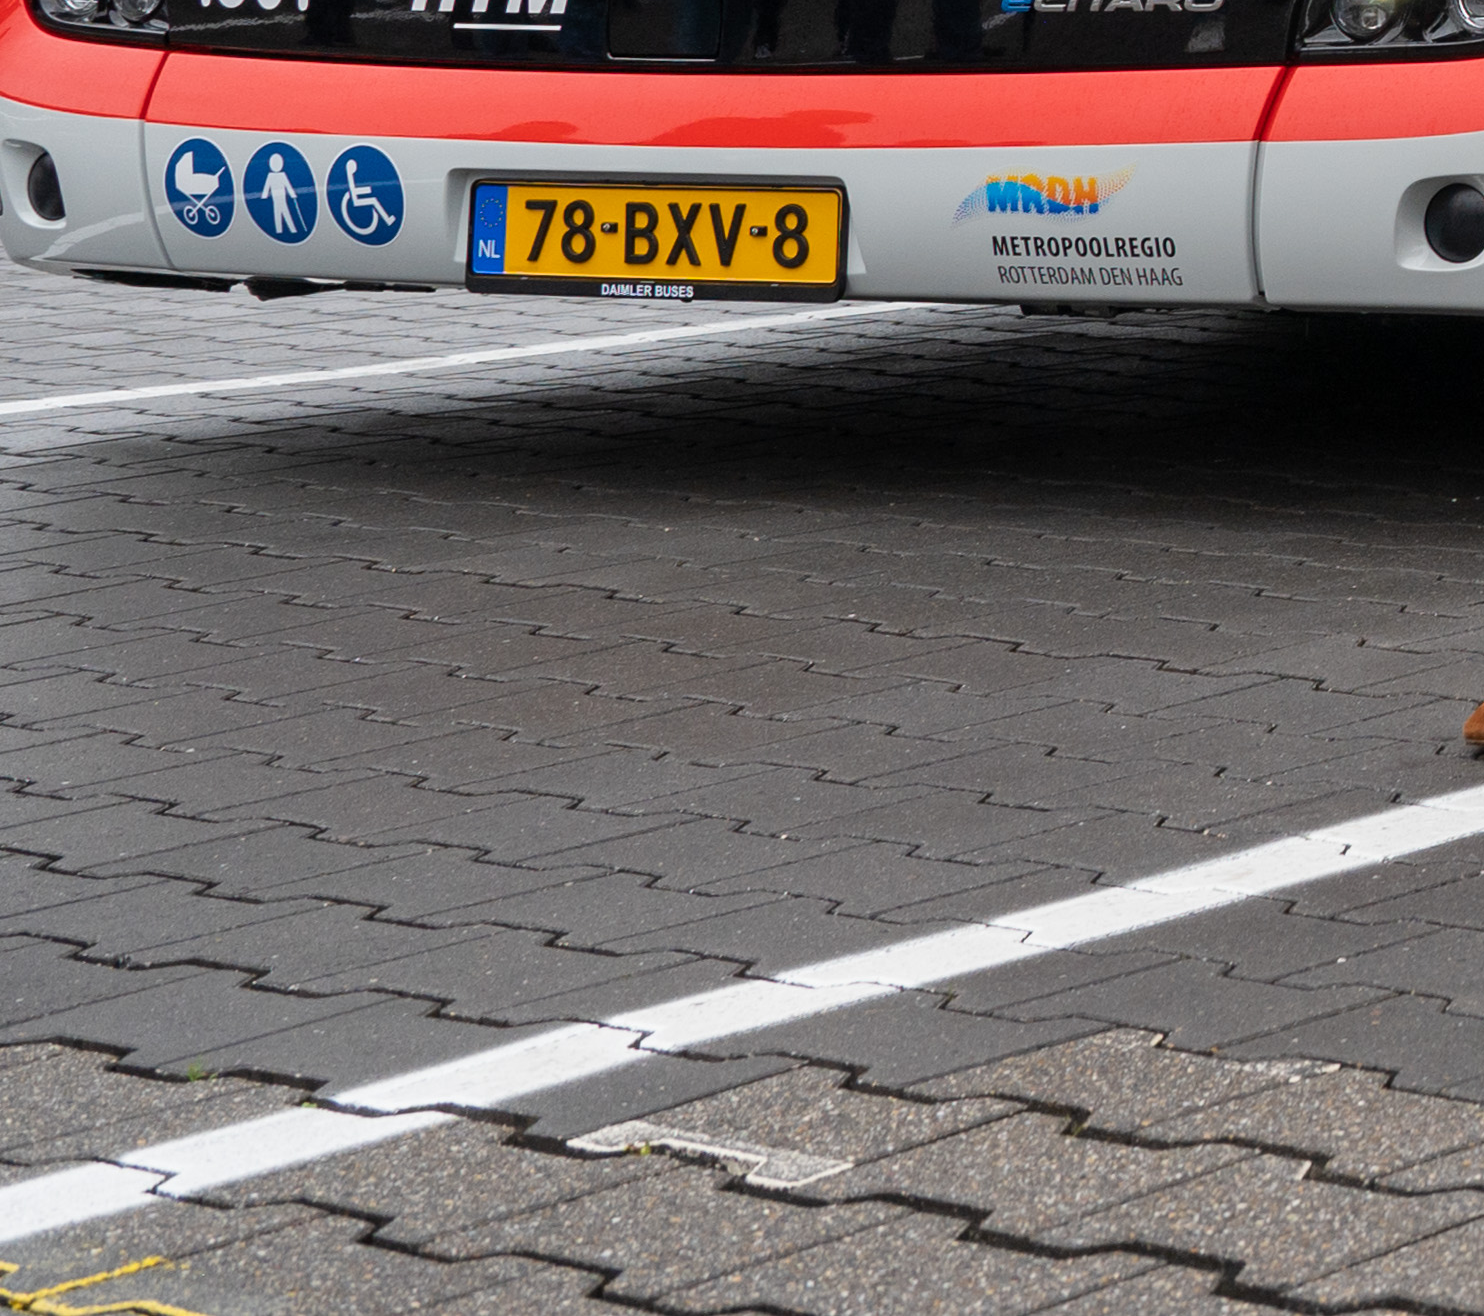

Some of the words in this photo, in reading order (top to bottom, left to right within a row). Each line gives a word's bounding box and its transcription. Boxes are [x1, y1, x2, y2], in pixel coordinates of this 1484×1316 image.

[986, 173, 1100, 215] MRDH
[524, 199, 810, 269] 78-BXV-8
[477, 239, 500, 259] NL
[991, 235, 1177, 258] METROPOOLREGIO
[997, 265, 1097, 285] ROTTERDAM
[1099, 267, 1134, 286] DEN
[1136, 268, 1184, 287] HAAG
[601, 283, 653, 297] DAIMLER
[654, 284, 694, 298] BUSES
